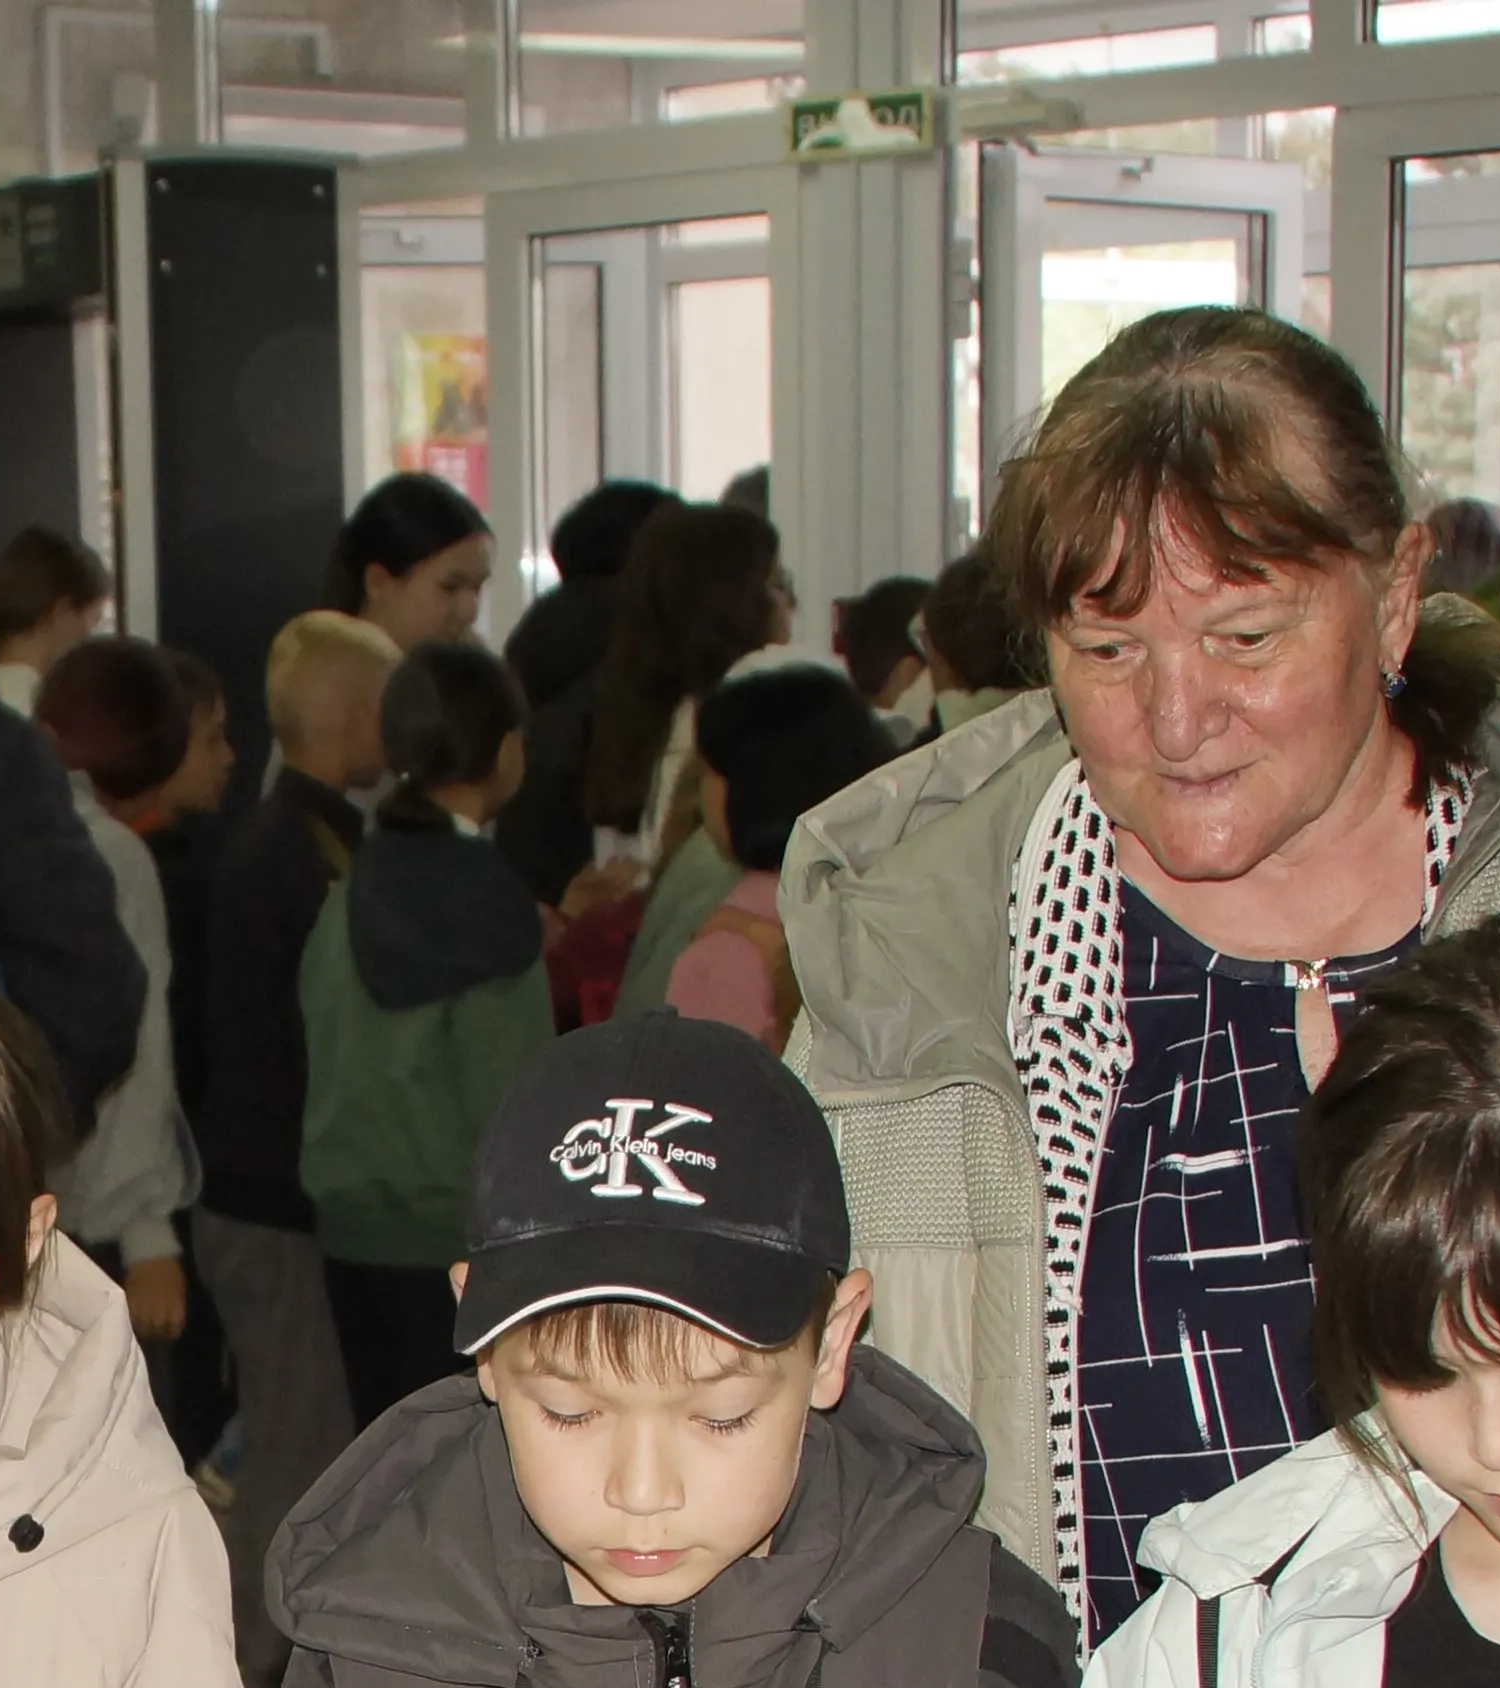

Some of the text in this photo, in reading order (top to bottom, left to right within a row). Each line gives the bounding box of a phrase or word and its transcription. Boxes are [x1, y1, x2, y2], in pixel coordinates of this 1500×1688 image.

[797, 105, 919, 140] ВОД
[550, 1139, 602, 1162] Calvin
[609, 1135, 659, 1155] Klein
